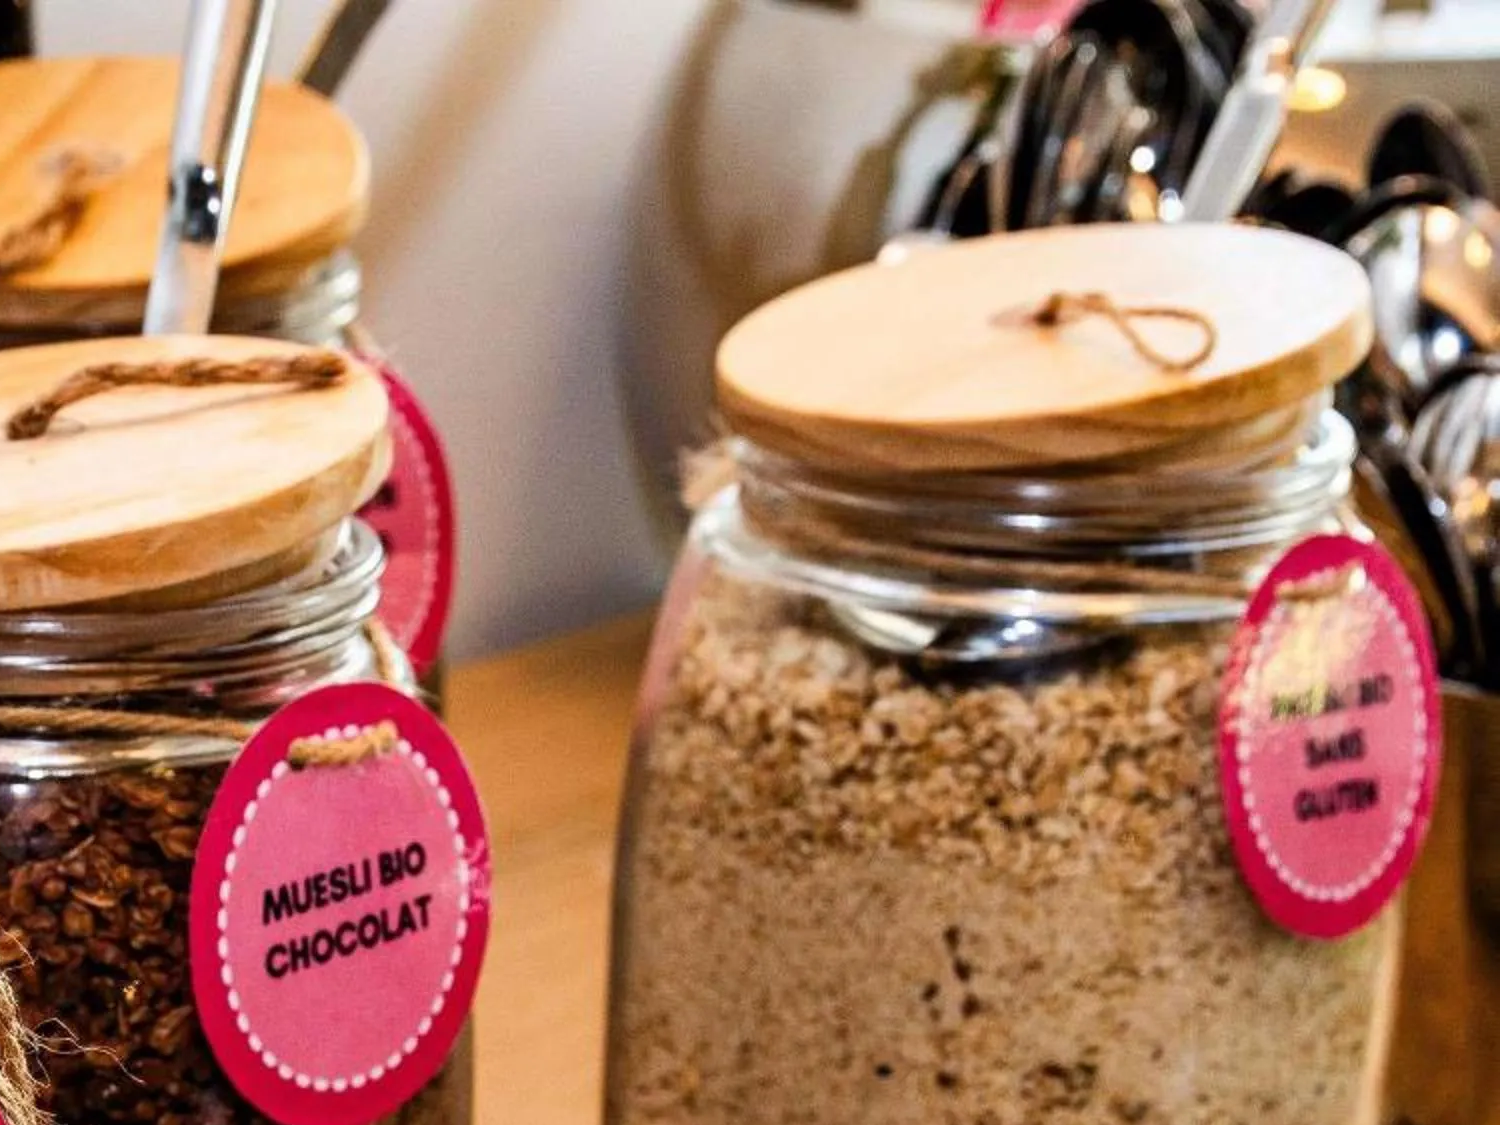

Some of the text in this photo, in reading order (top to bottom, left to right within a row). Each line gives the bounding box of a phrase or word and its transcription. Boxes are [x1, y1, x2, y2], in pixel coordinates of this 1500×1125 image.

[262, 841, 427, 926] MUESLI BIO
[264, 895, 433, 979] CHOCOLAT
